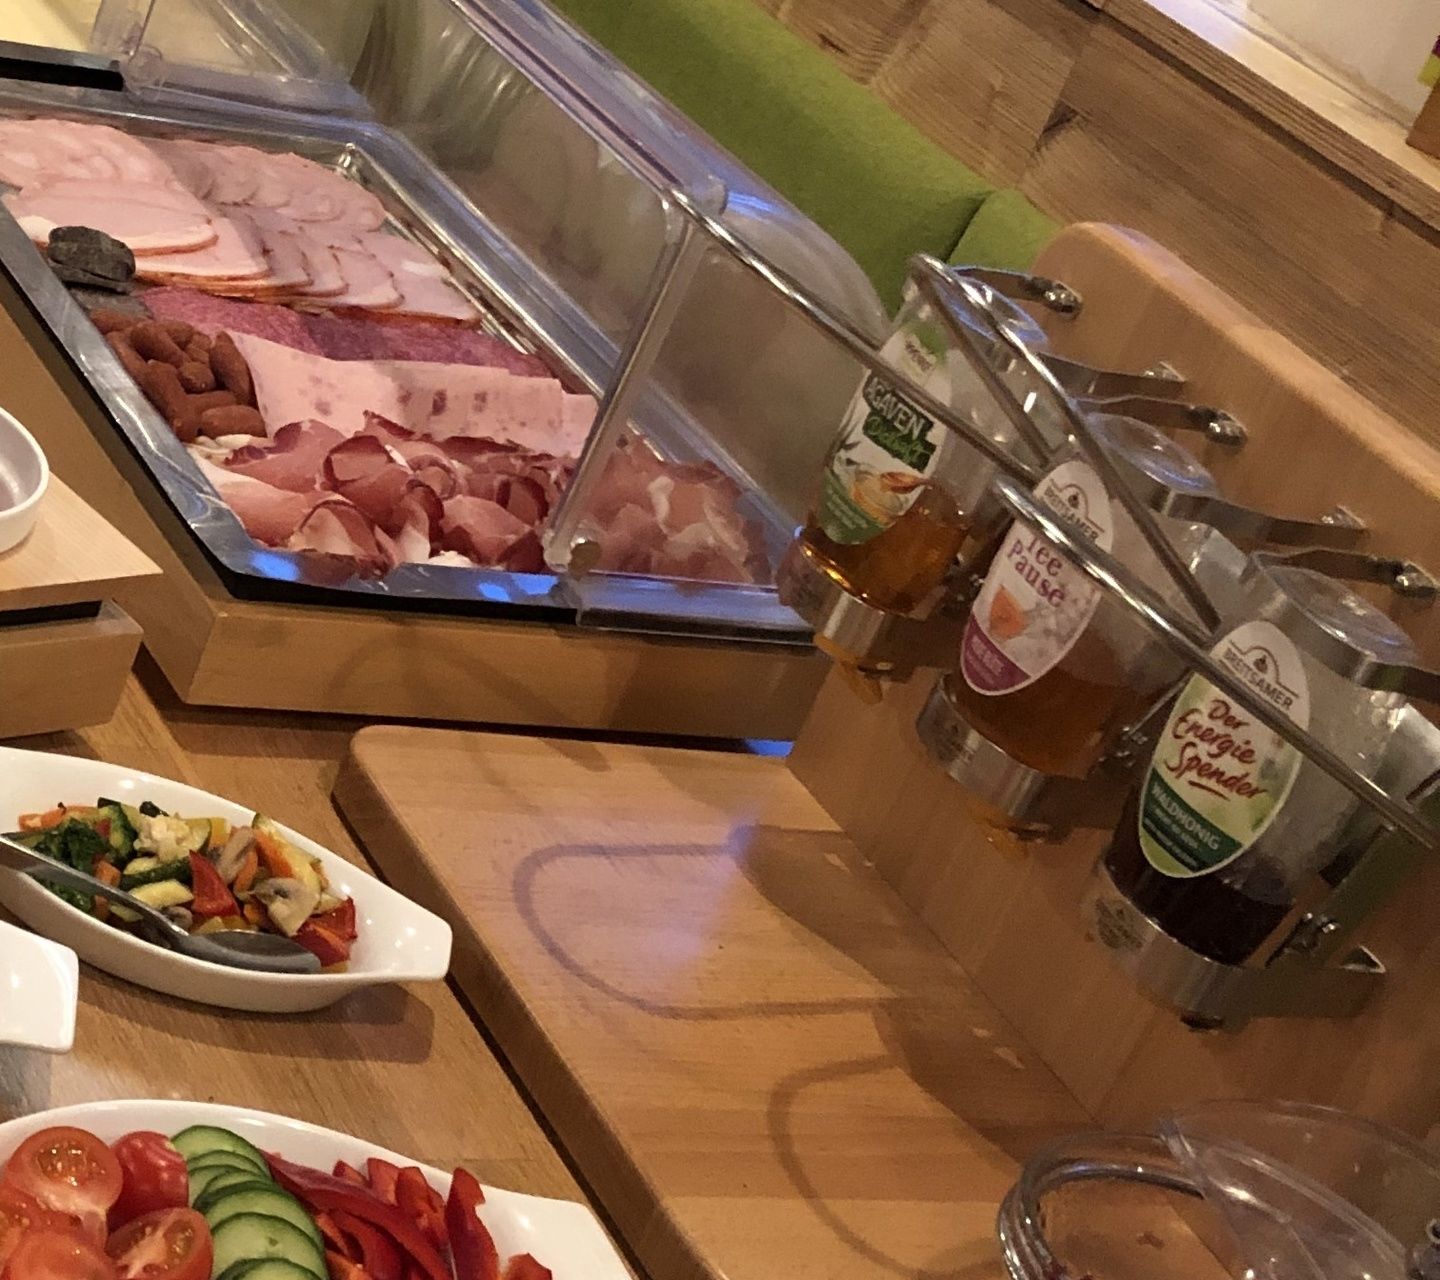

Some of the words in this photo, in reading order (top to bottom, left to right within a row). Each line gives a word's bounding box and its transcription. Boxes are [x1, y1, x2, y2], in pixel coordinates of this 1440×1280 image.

[1007, 539, 1066, 608] Pause
[1223, 647, 1295, 711] BREITSAMER
[1171, 708, 1257, 763] Energie
[1207, 699, 1250, 728] Der
[1164, 741, 1269, 799] Spender
[1151, 783, 1221, 851] WALDHONIG
